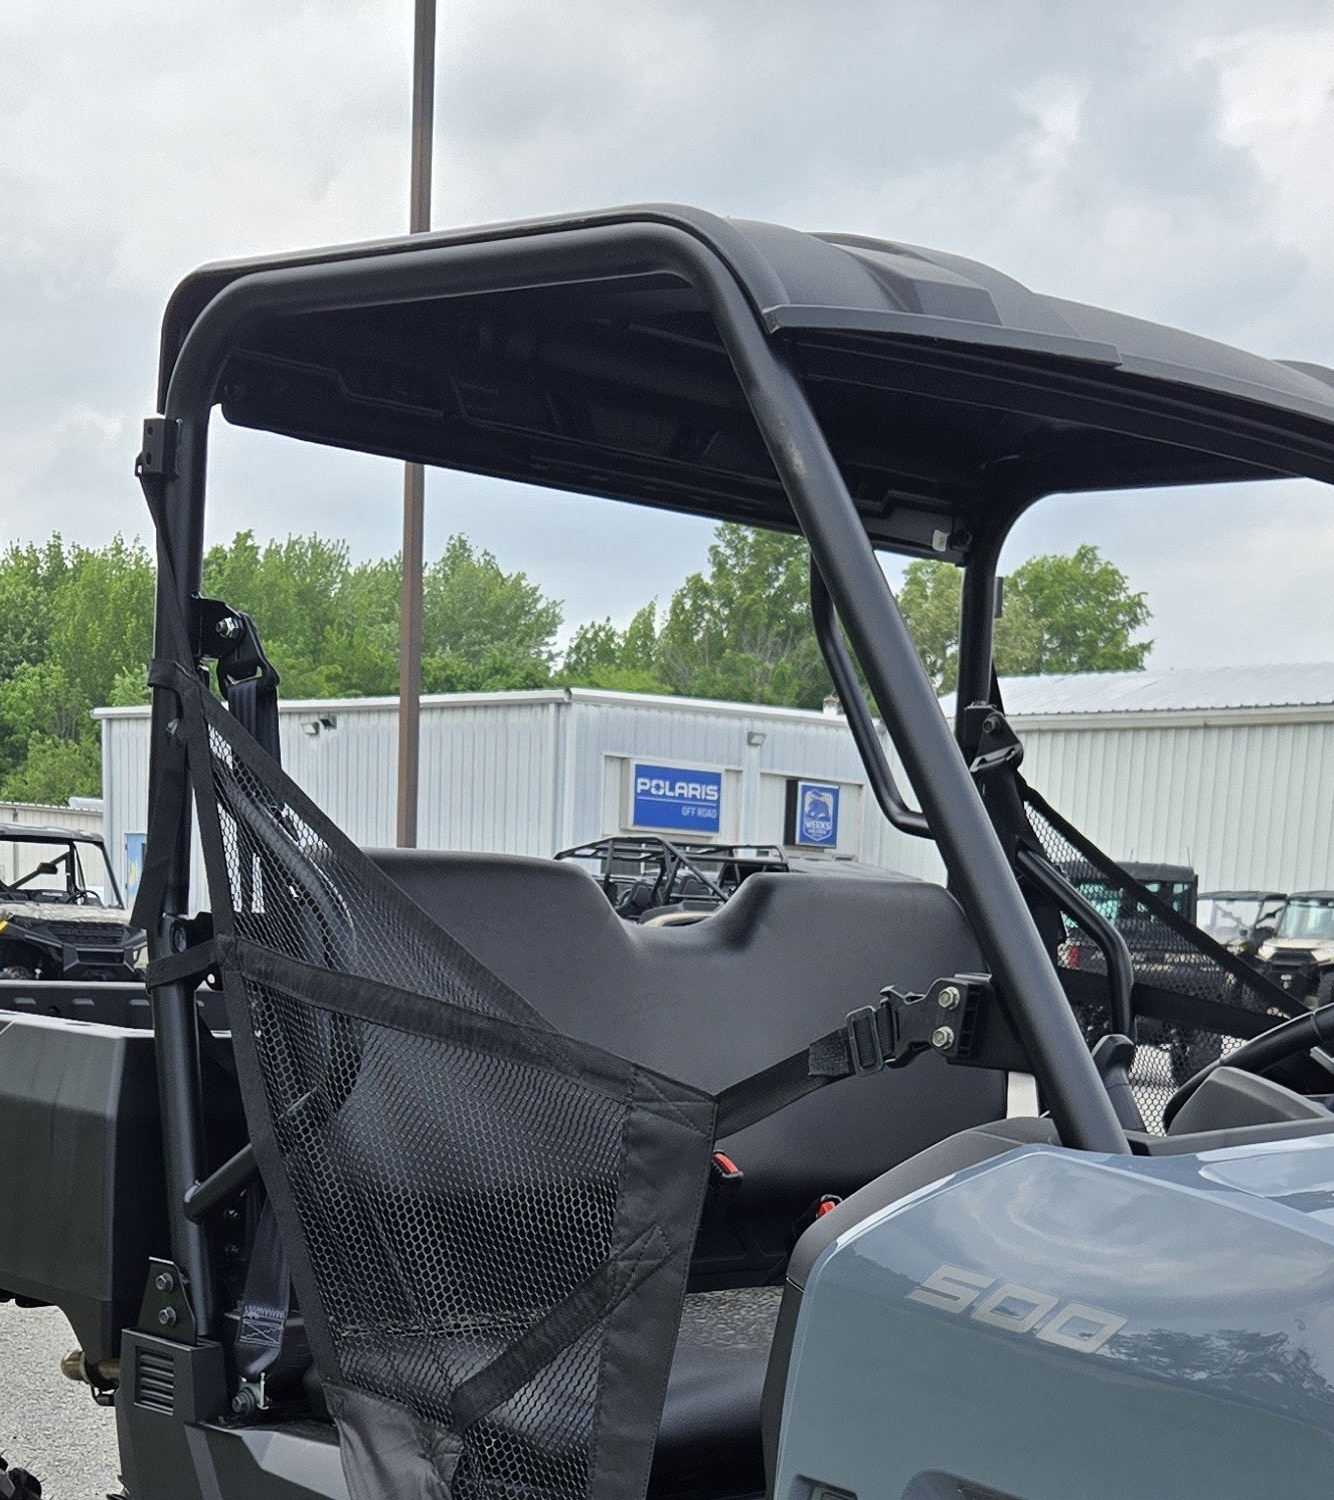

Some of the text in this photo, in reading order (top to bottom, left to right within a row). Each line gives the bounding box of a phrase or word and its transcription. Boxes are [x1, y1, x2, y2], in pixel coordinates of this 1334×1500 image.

[637, 777, 719, 801] POLARIS
[681, 806, 717, 819] OFF ROAD
[905, 1263, 1129, 1354] 500
